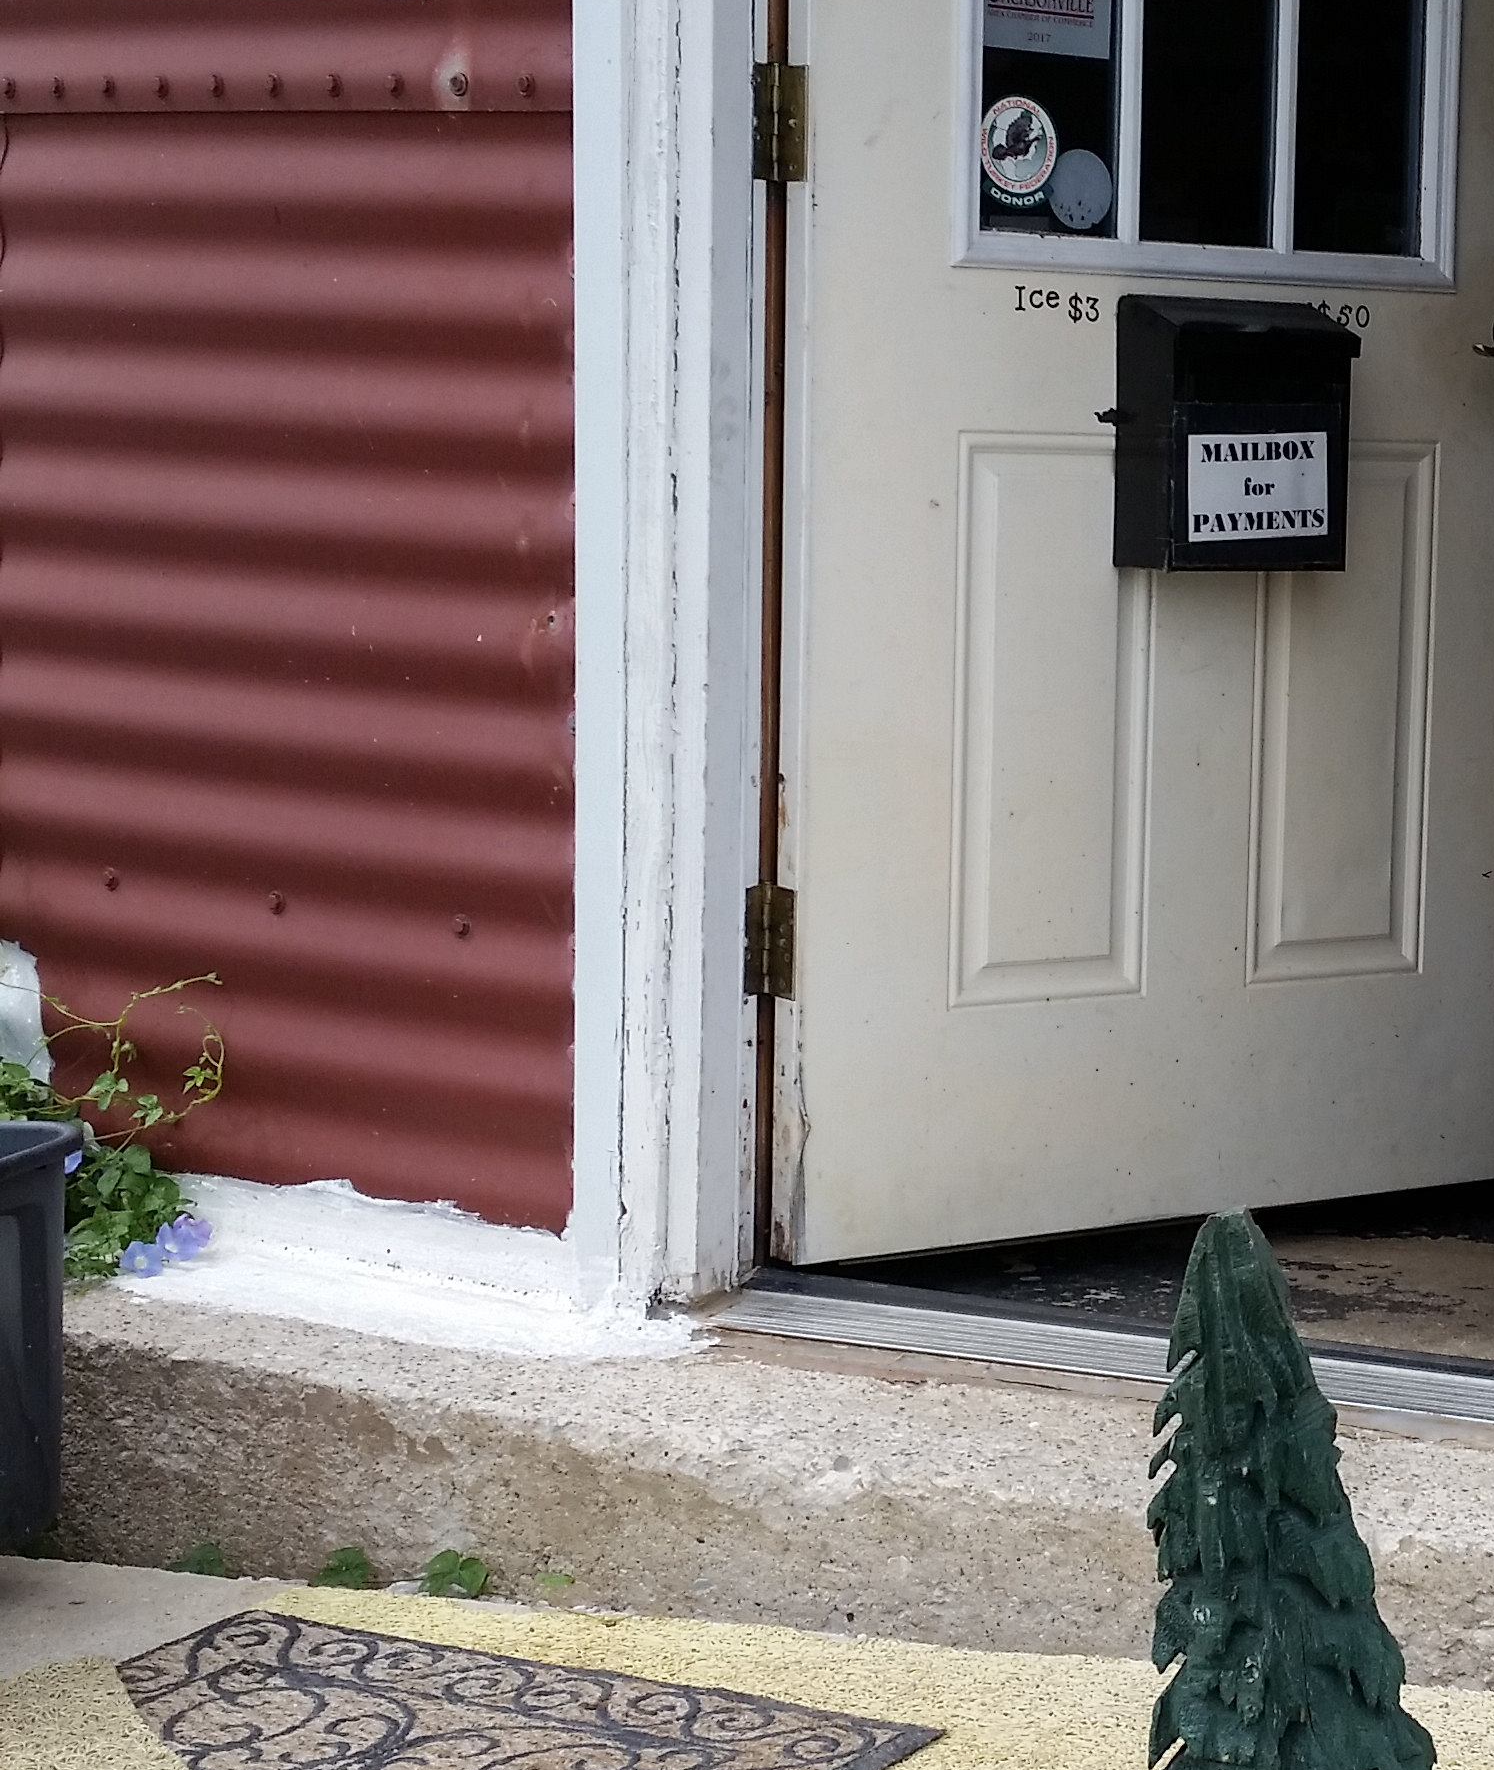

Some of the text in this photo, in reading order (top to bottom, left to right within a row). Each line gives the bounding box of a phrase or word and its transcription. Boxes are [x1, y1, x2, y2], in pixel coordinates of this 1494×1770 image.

[1028, 32, 1051, 42] 2017
[993, 99, 1041, 116] NATIONAL
[986, 160, 1016, 190] TURKEY
[1019, 136, 1054, 190] FEDERATION
[990, 186, 1045, 206] DONOR
[1015, 286, 1100, 323] Ice $3
[1201, 440, 1315, 463] MAILBOX
[1244, 477, 1275, 497] for
[1192, 508, 1325, 533] PAYMENTS
